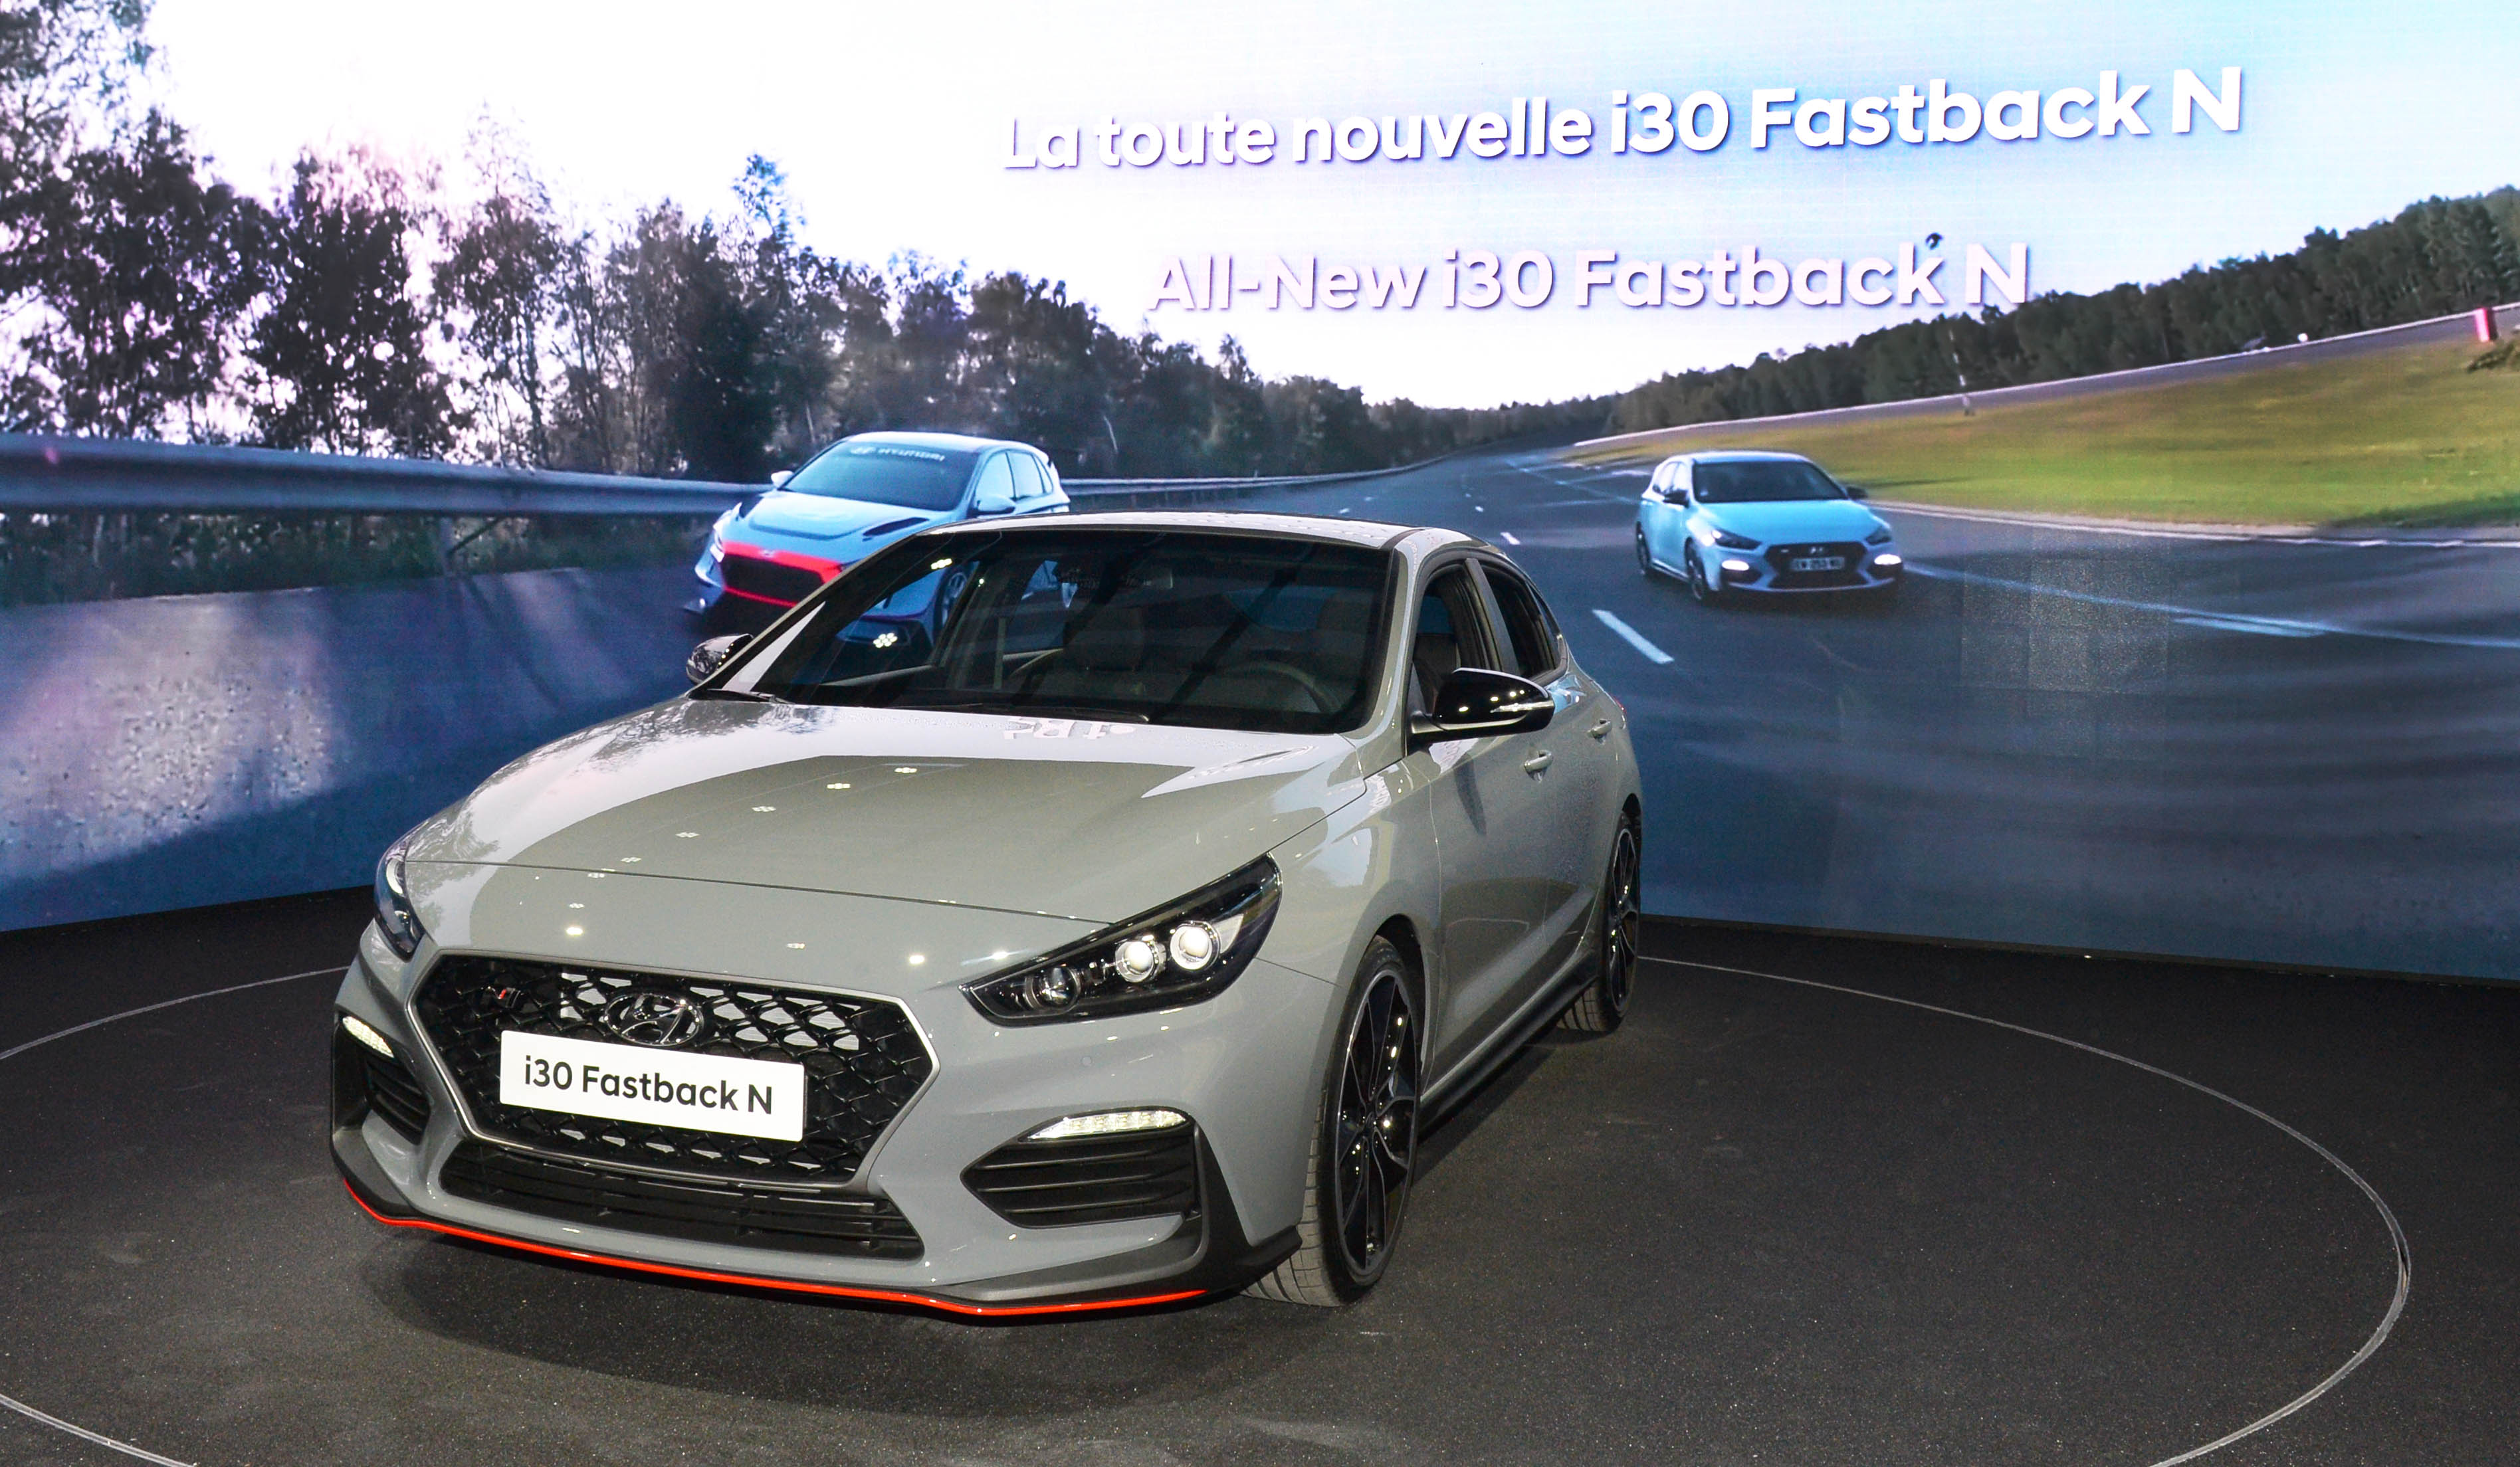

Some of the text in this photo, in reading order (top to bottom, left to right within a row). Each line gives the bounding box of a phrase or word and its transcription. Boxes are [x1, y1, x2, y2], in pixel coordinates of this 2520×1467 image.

[1004, 66, 2242, 169] La toute nouvelle i30 Fastback N
[1146, 241, 2028, 310] All-New i30 Fastback N
[525, 1055, 772, 1115] i30 Fastback N
